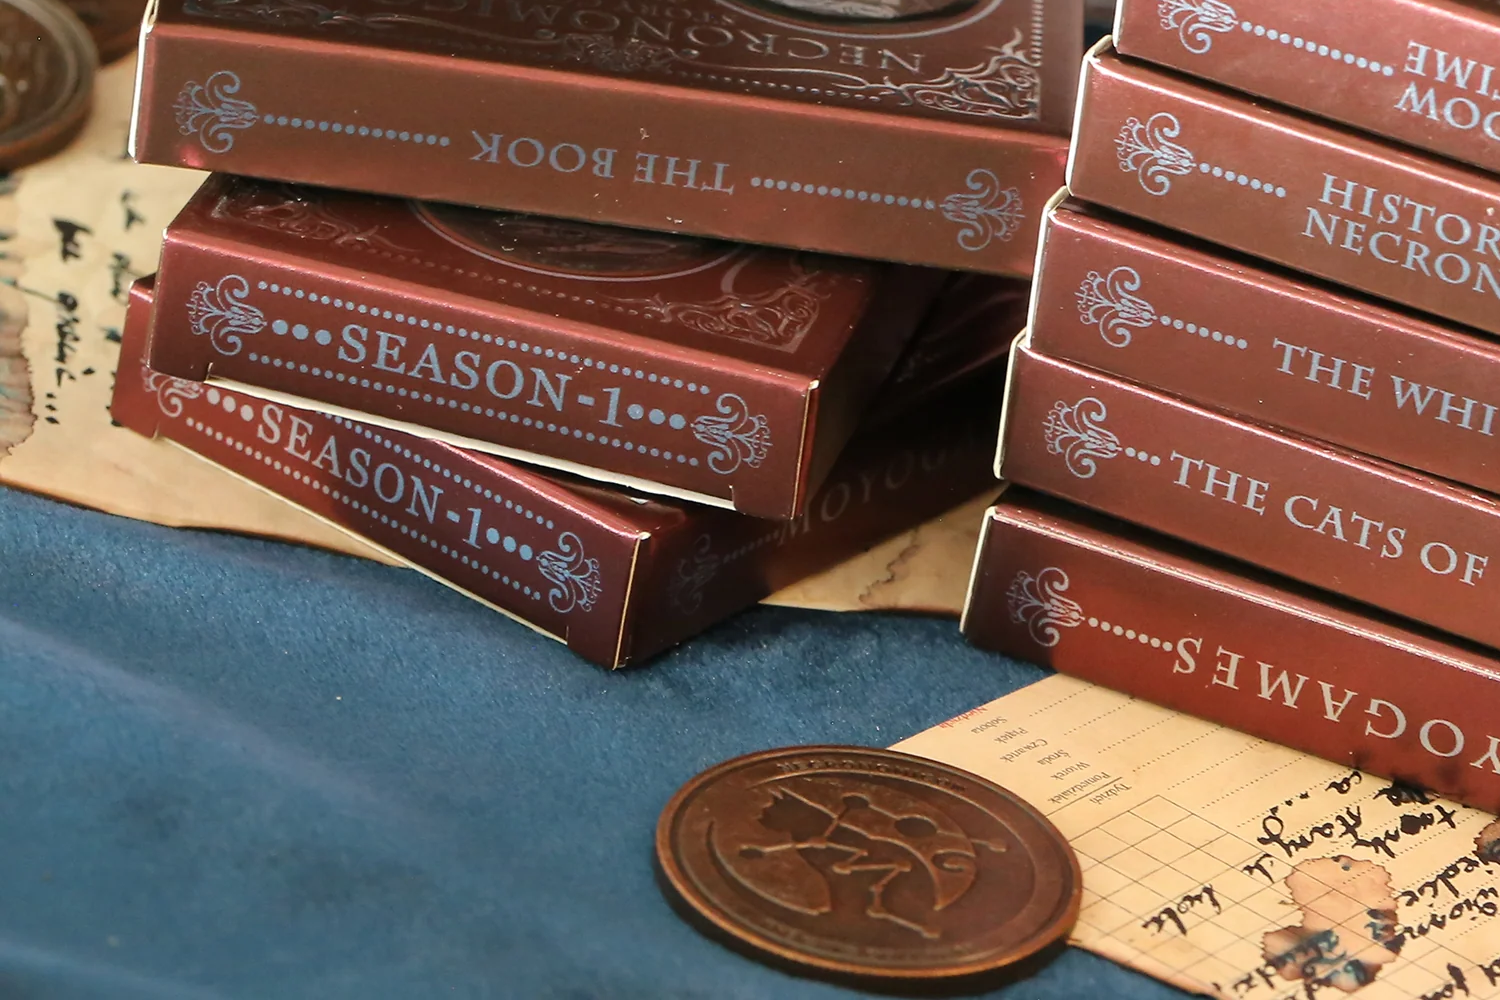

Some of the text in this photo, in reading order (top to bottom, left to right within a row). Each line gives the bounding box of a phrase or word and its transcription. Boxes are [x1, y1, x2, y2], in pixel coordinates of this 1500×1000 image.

[469, 129, 736, 195] THE BOOK
[336, 323, 626, 430] SEASON-1
[1272, 337, 1377, 400] THE
[256, 403, 486, 550] SEASON-1
[1169, 450, 1271, 516] THE
[1284, 494, 1408, 560] CATS
[1419, 541, 1489, 587] OF
